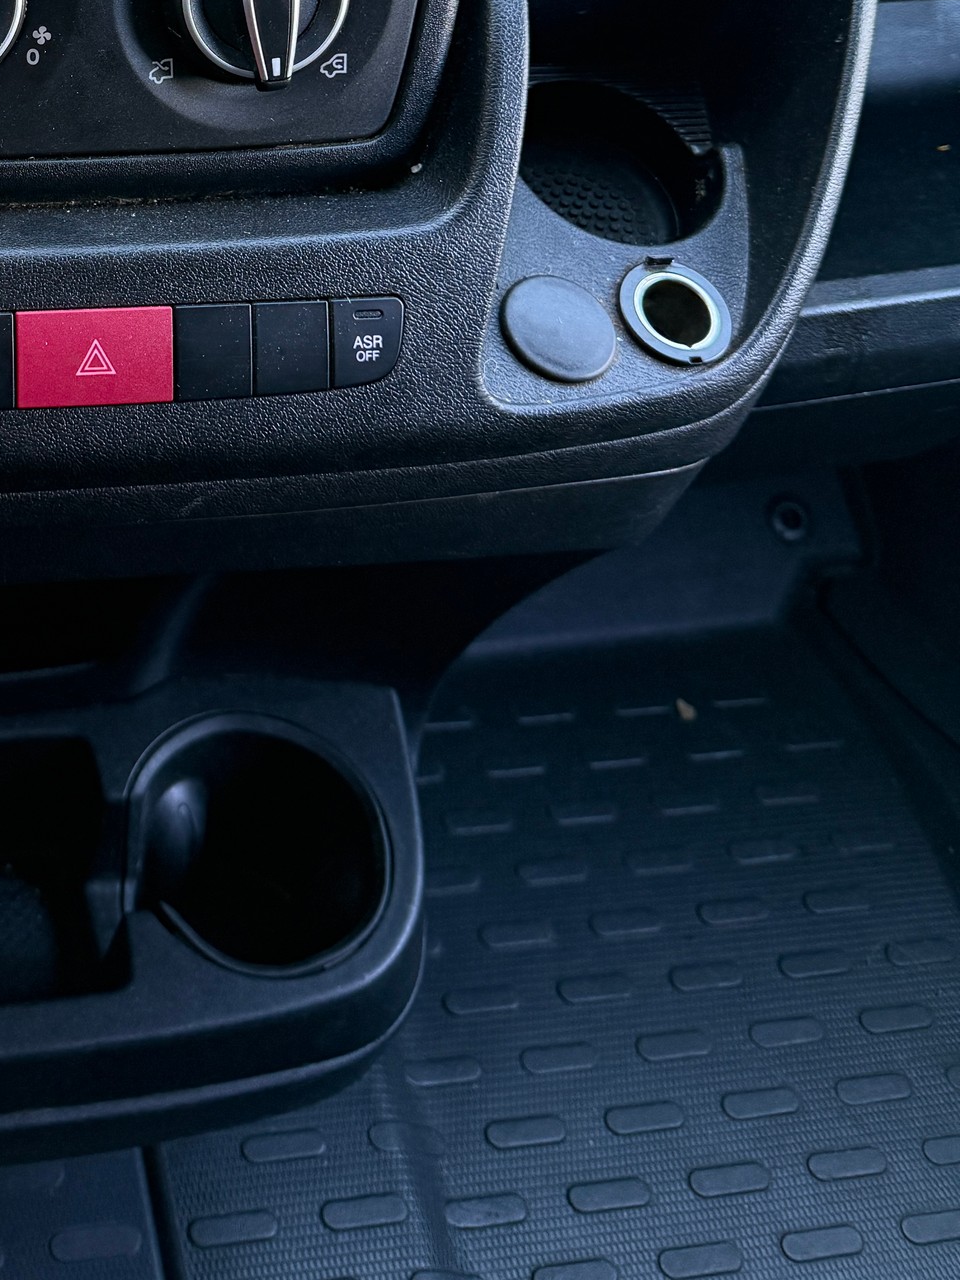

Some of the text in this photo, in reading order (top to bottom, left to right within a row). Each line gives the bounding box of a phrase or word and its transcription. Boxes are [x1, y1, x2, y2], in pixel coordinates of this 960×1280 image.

[26, 49, 40, 66] 0
[353, 335, 383, 349] ASR
[355, 350, 380, 362] OFF
